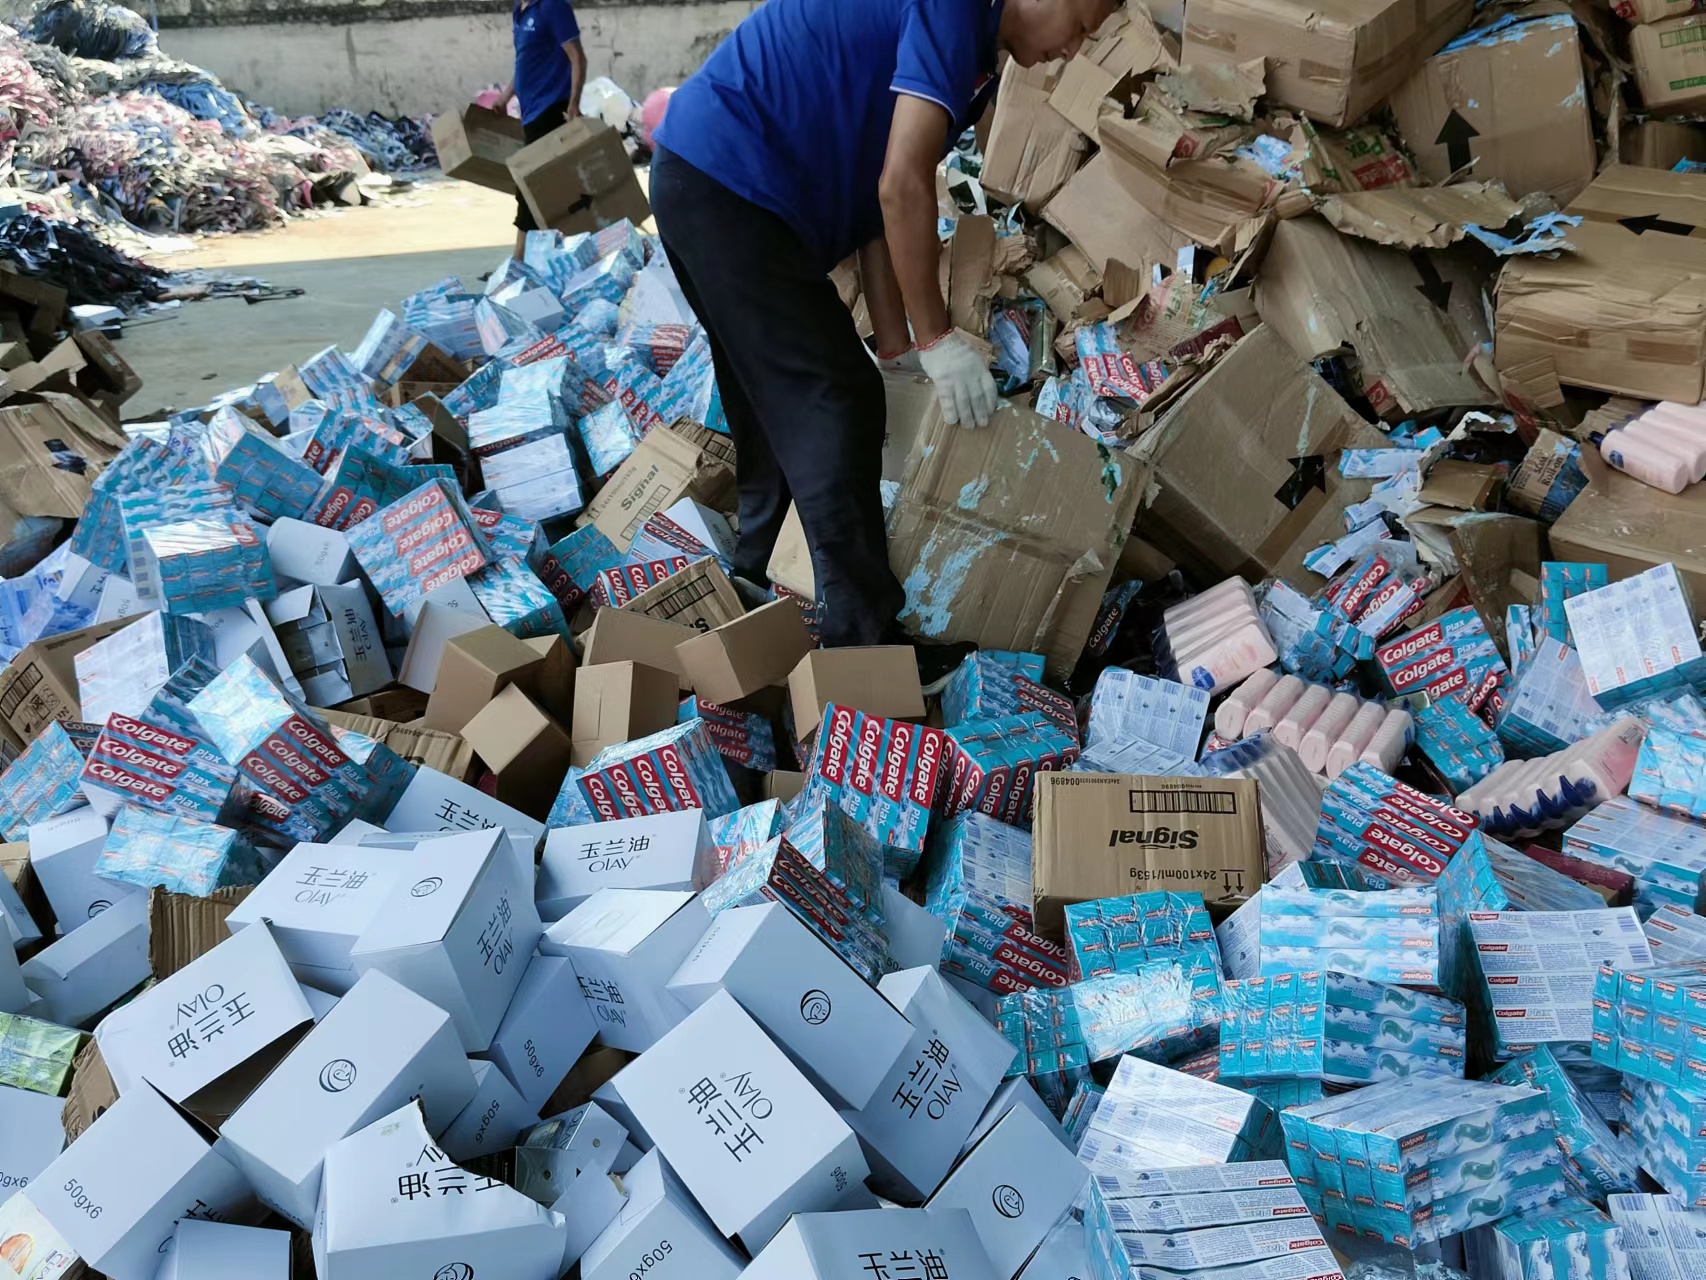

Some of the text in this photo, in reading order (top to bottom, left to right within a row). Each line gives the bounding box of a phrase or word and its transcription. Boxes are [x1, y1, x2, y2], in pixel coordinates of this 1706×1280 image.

[387, 491, 440, 529] Colgate
[621, 464, 660, 511] Signal
[399, 512, 453, 549] Colgate
[413, 533, 467, 571] Colgate
[427, 554, 480, 590] Colgate
[1345, 564, 1385, 611] Colgate
[1089, 608, 1118, 649] Colgate
[1383, 629, 1439, 664] Colgate
[1445, 619, 1466, 633] Plax
[1394, 642, 1477, 686] Colgate Plax
[1019, 692, 1075, 727] Colgate
[111, 716, 222, 764] Colgate Plax
[288, 720, 362, 783] Colgate Plax
[826, 710, 851, 778] Colgate
[88, 762, 200, 810] Colgate Plax
[100, 740, 212, 787] Colgate Plax
[268, 739, 343, 801] Colgate Plax
[663, 749, 696, 810] Colgat
[850, 719, 881, 819] Colgate Plax
[879, 726, 910, 826] Colgate Plax
[908, 732, 940, 833] Colgate Plax
[247, 756, 322, 818] Colgate Plax
[613, 768, 641, 818] Colga
[983, 774, 1005, 814] Colga
[1361, 779, 1463, 838] Plax Colgate
[1109, 827, 1199, 850] Signal
[1336, 834, 1360, 851] Plax
[1340, 811, 1441, 874] Plax Colgate
[1348, 794, 1450, 853] Plax Colgate
[578, 835, 650, 860] 玉兰油
[588, 856, 634, 873] OLAY
[296, 866, 369, 889] 玉兰油
[779, 858, 845, 921] Colgate
[1129, 867, 1217, 881] 24x100ml/153g
[295, 889, 341, 907] OLAY
[477, 897, 512, 966] 玉兰油
[494, 933, 514, 975] OLAY
[983, 910, 1007, 928] Plax
[1014, 926, 1067, 963] olgate
[968, 958, 992, 977] Plax
[971, 932, 995, 951] Plax
[1001, 948, 1068, 988] Colgate
[168, 991, 255, 1059] 玉兰油
[175, 983, 226, 1027] OLAY
[597, 1004, 627, 1028] OLAY
[524, 1039, 545, 1078] 50gx6
[892, 1038, 950, 1119] 玉兰油
[724, 1071, 774, 1120] OLAY
[927, 1068, 963, 1120] OLAY
[475, 1100, 501, 1144] 50gx6
[688, 1077, 764, 1163] 玉兰油
[64, 1178, 103, 1220] 50gx6
[830, 1166, 848, 1192] 50gx6
[1590, 1165, 1620, 1191] Plax
[1274, 1208, 1307, 1216] Colgate
[1290, 1240, 1325, 1249] Colgate
